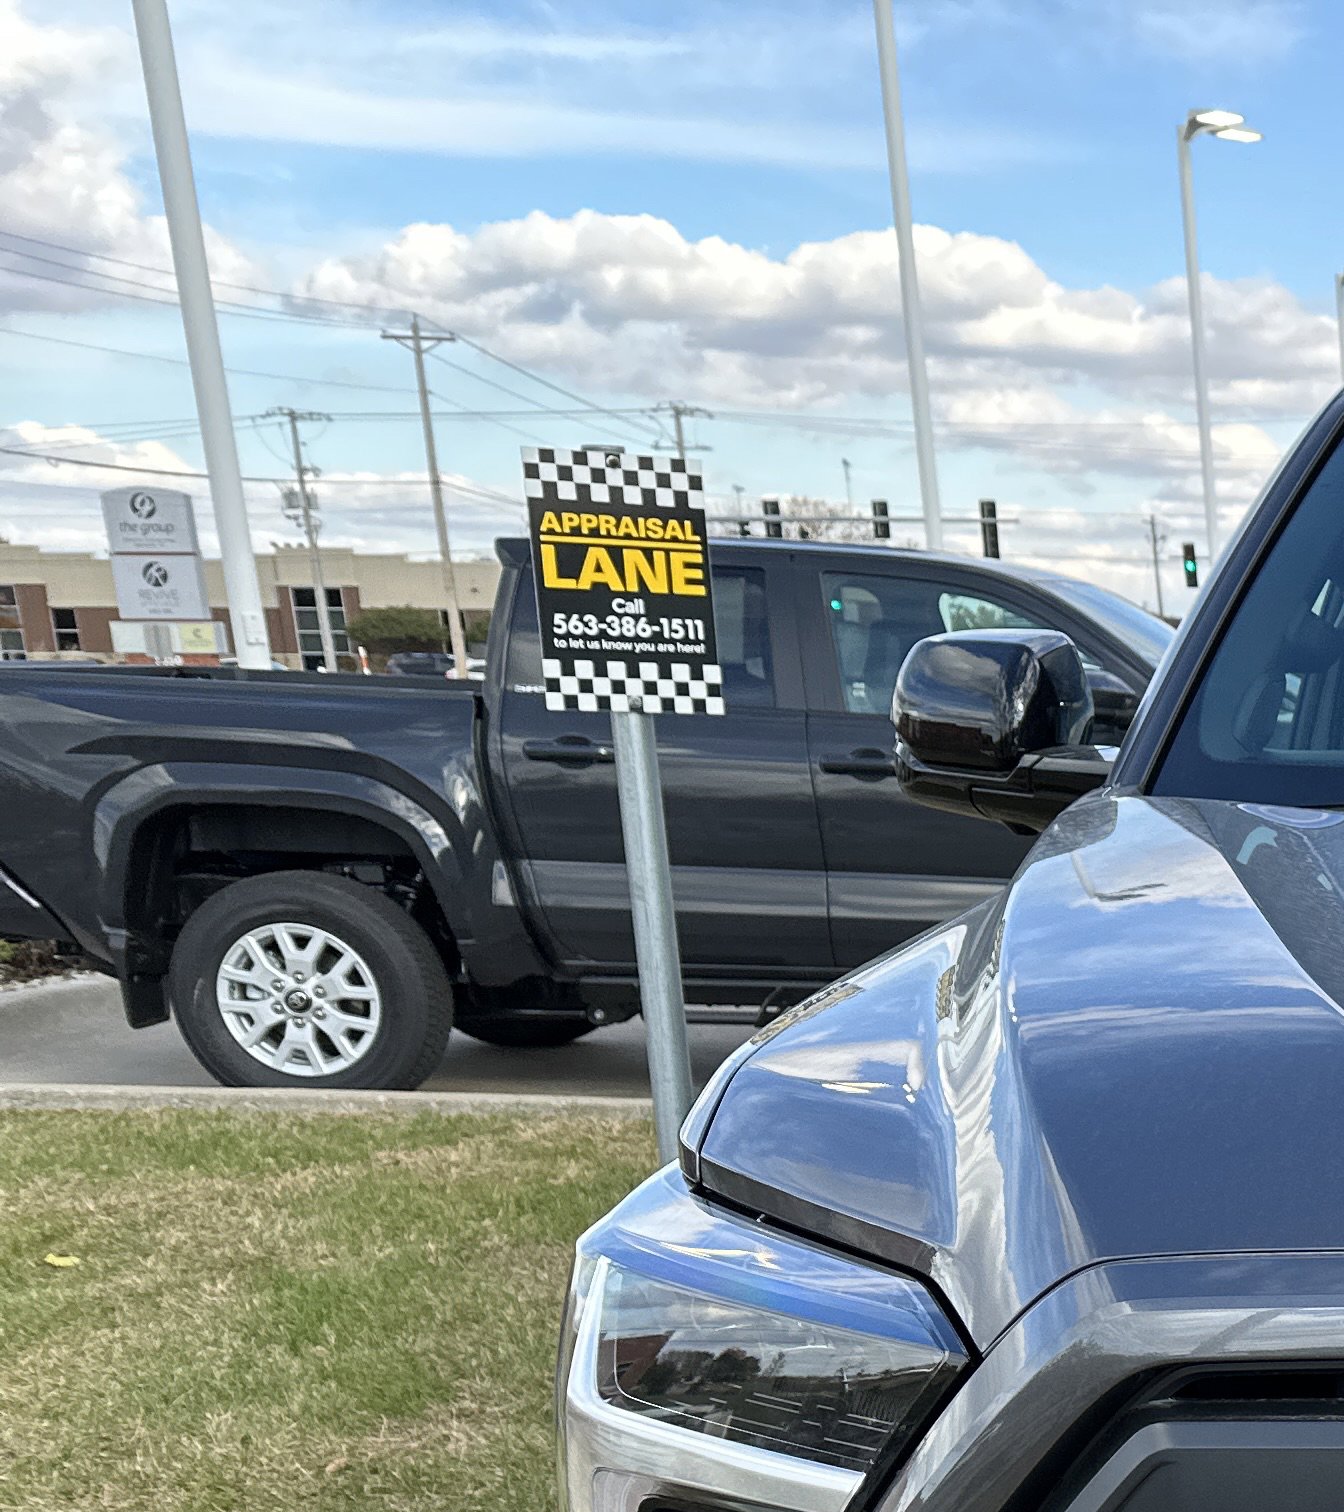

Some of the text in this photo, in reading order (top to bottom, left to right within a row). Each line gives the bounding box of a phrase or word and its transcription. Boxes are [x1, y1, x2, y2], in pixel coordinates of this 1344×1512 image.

[140, 523, 175, 536] group
[540, 511, 701, 541] APPRAISAL
[540, 543, 706, 597] LANE
[611, 597, 645, 615] Call
[552, 612, 706, 641] 563-386-1511
[553, 637, 567, 648] to
[569, 638, 585, 649] let
[587, 639, 600, 650] us
[602, 639, 633, 651] know
[634, 642, 656, 653] you
[657, 643, 675, 653] are
